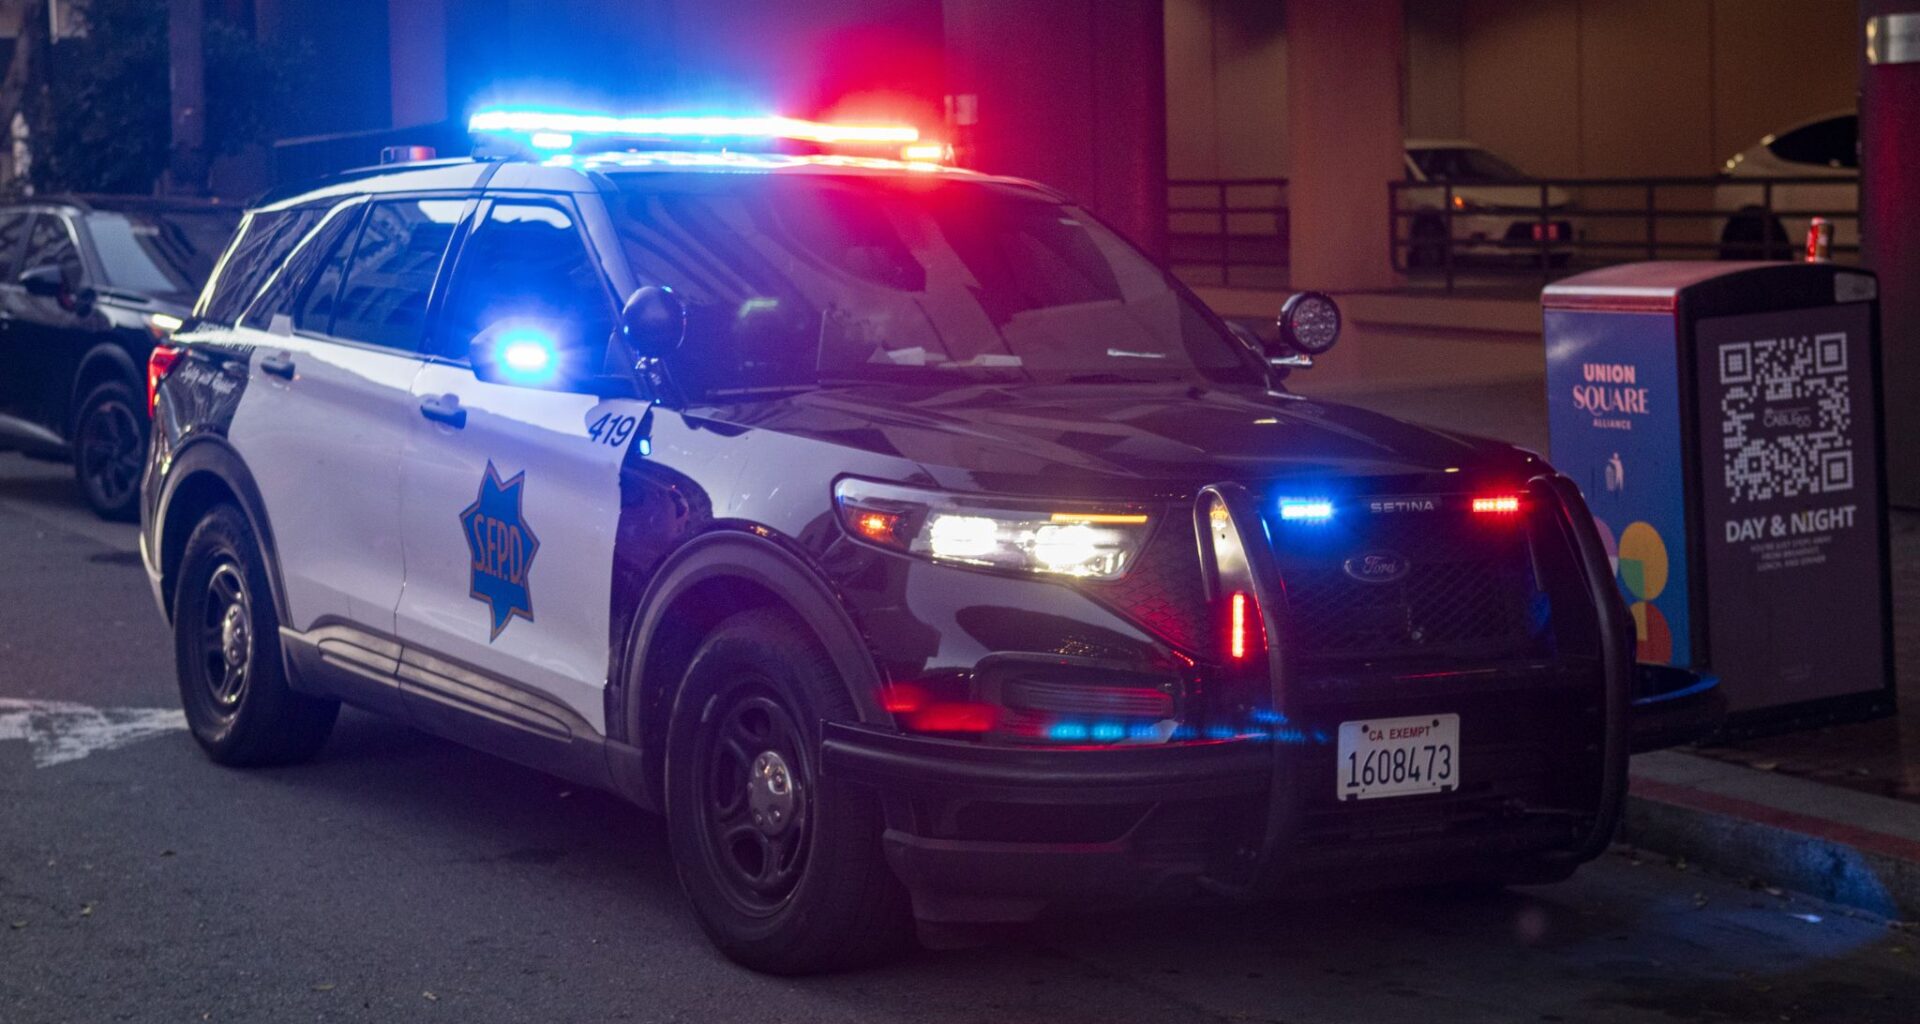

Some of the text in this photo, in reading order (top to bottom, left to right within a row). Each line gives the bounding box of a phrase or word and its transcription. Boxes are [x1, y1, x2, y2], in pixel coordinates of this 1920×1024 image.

[1583, 363, 1636, 384] UNION
[1573, 385, 1650, 417] SQUARE
[588, 412, 636, 447] 419
[1593, 418, 1632, 430] ALLIANCE
[1370, 501, 1435, 513] SETINA
[1725, 505, 1857, 543] DAY & NIGHT
[1363, 555, 1397, 575] Ford
[1368, 726, 1431, 741] CA EXEMPT
[1347, 744, 1451, 787] 1608473
